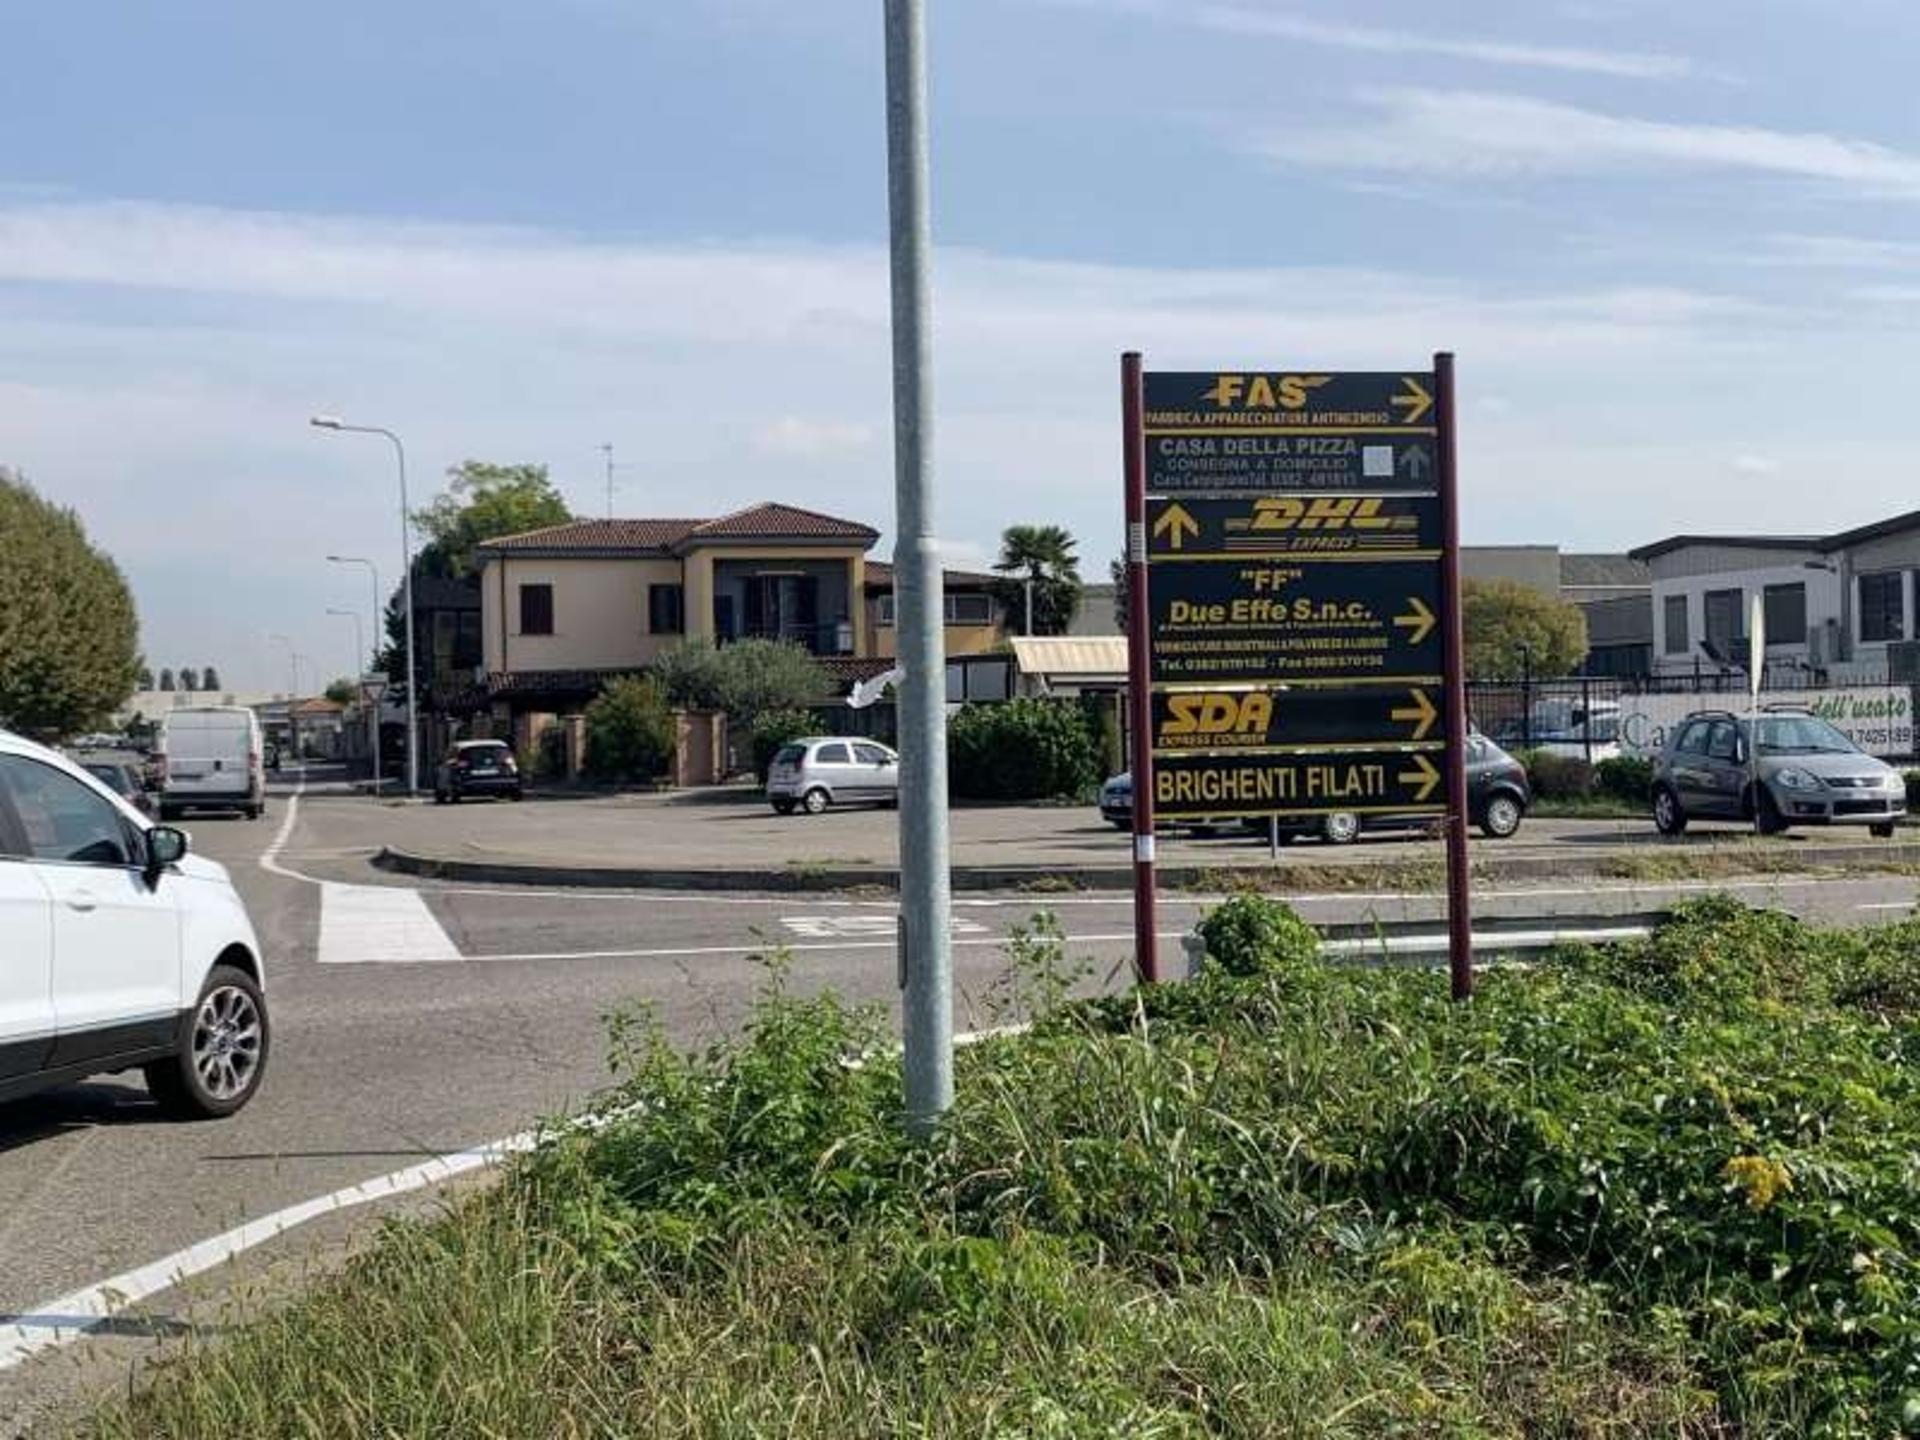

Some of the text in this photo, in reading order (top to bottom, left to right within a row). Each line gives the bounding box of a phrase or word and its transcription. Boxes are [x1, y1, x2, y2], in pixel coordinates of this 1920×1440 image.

[1214, 375, 1312, 409] FAS
[1159, 438, 1358, 457] CASA DELLA PIZZA
[1166, 458, 1348, 471] CONSEGNA A DOMICILIO
[1250, 498, 1392, 530] DHL
[1240, 569, 1304, 592] "FF"
[1170, 598, 1373, 624] Due Effe S.n.c.
[1160, 693, 1274, 733] SDA
[1157, 735, 1211, 748] EXPRESS
[1157, 764, 1384, 803] BRIGHENTI FILATI
